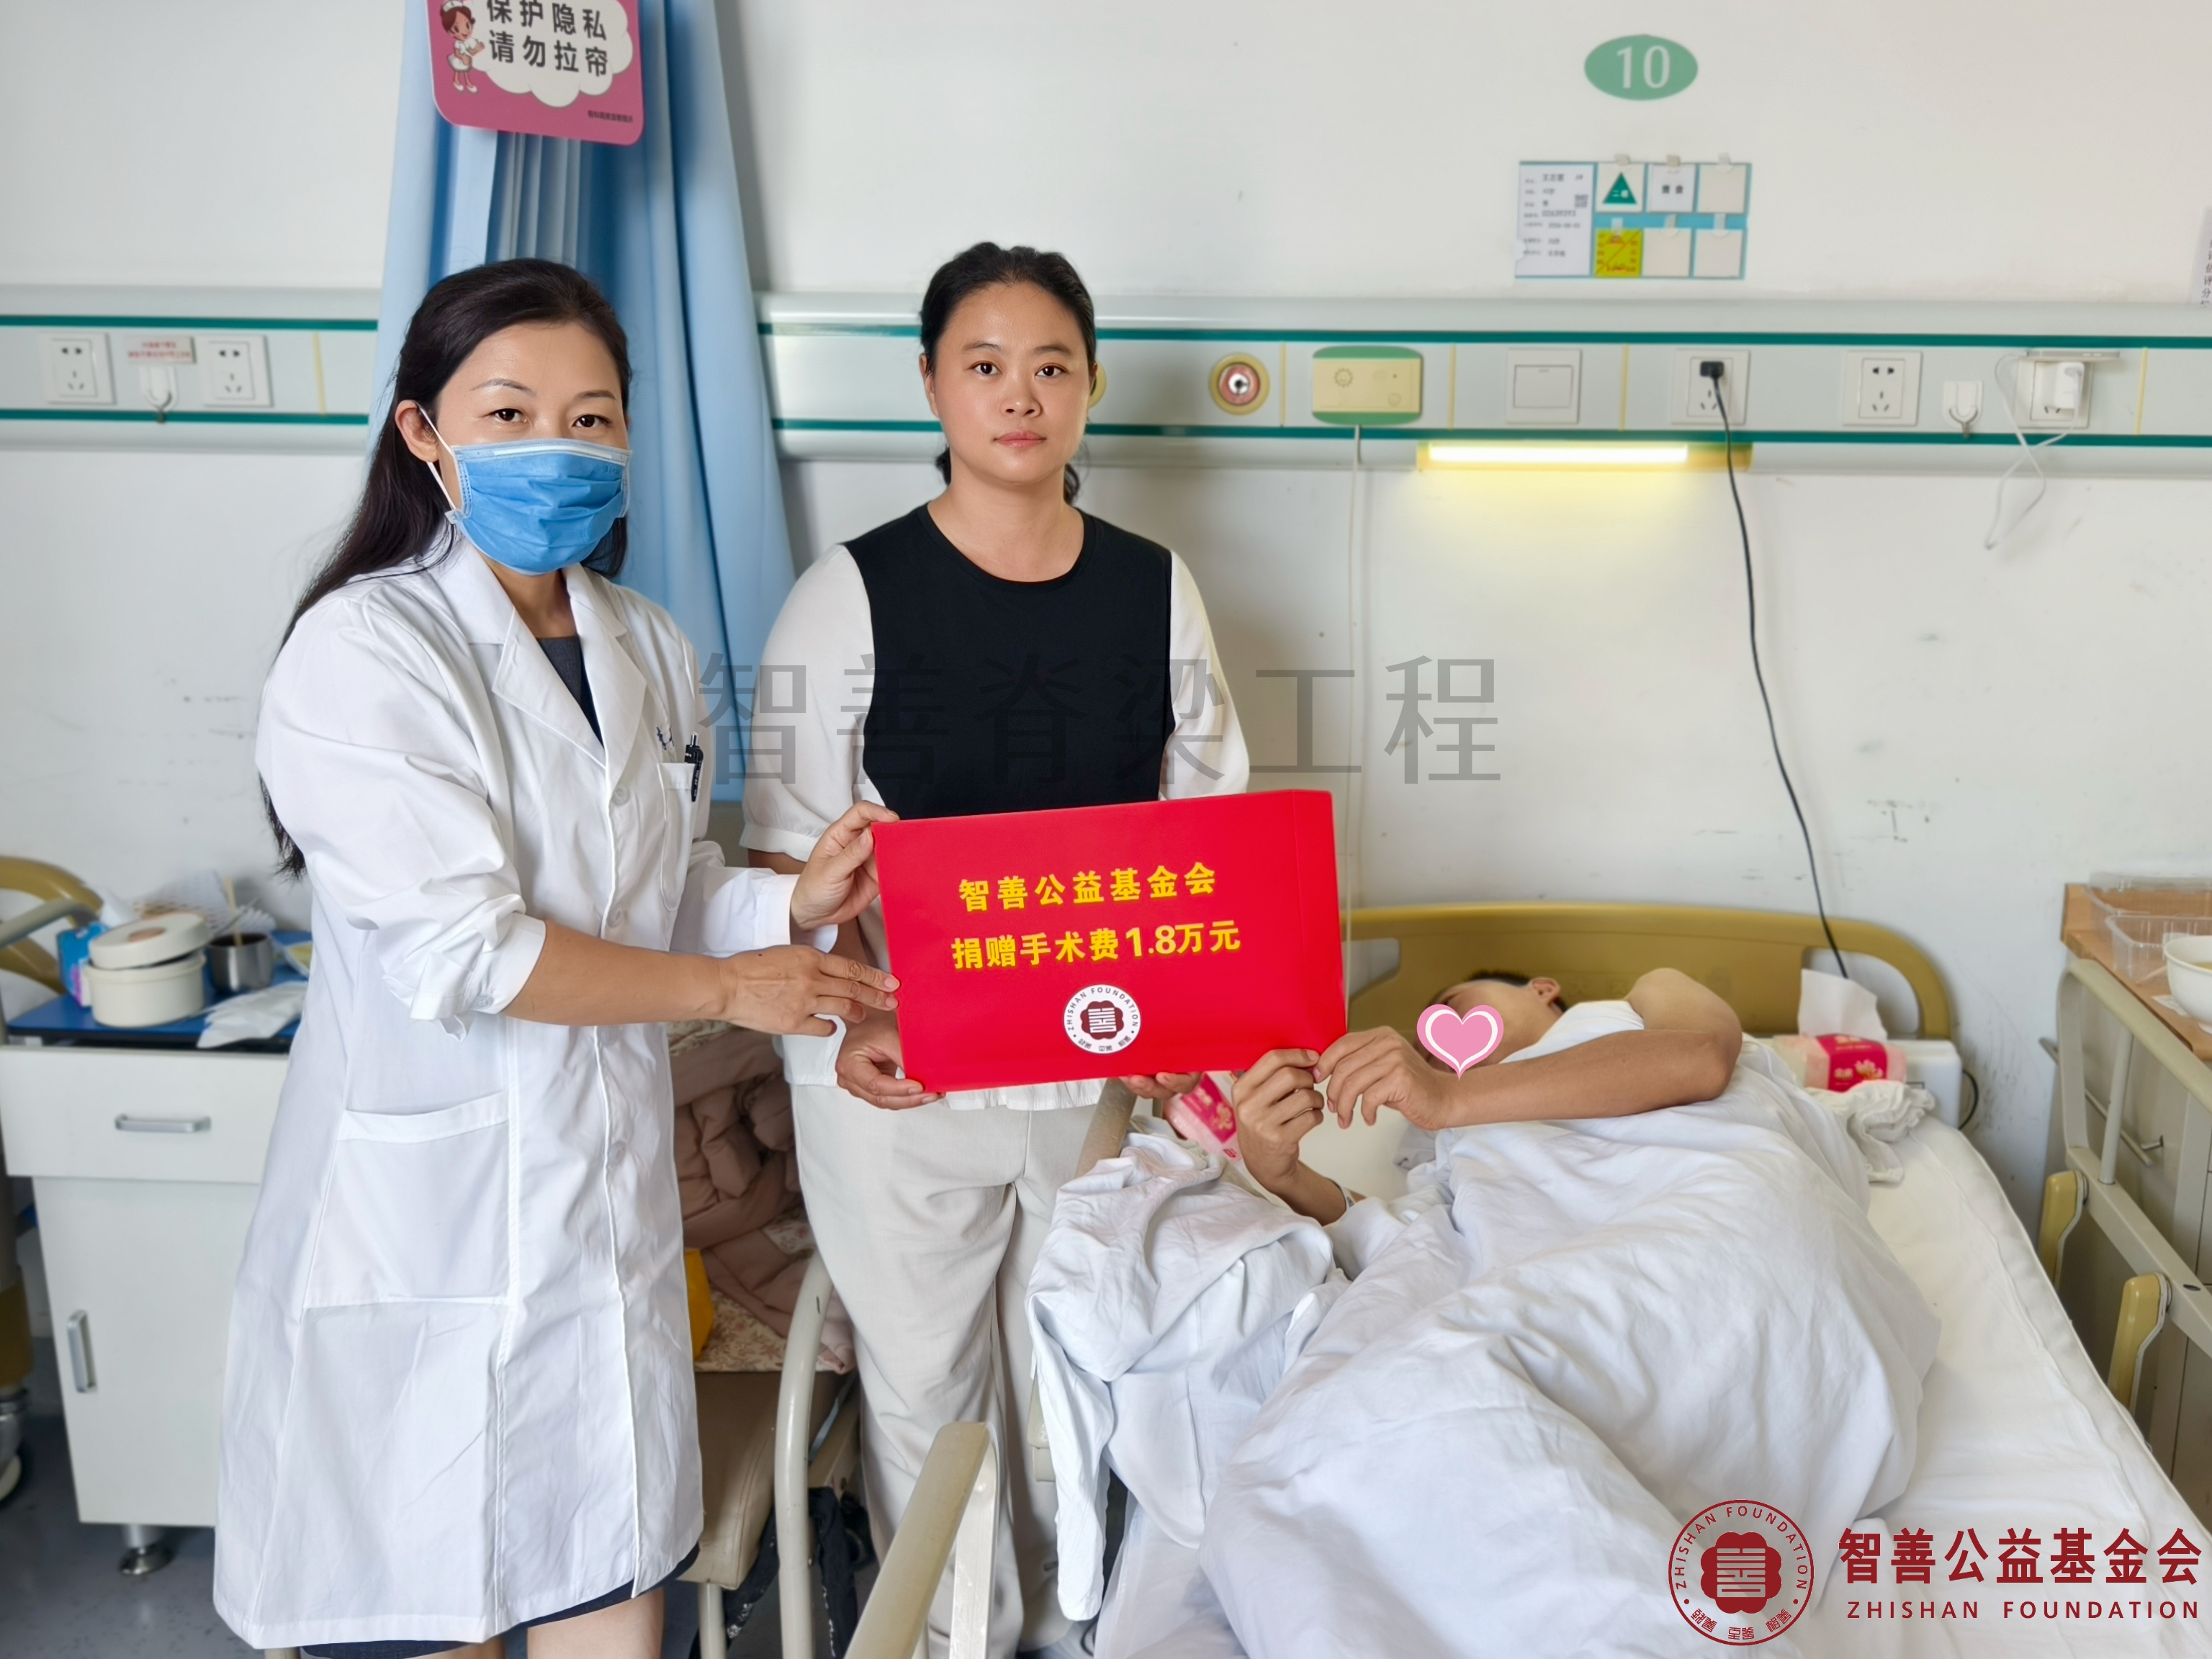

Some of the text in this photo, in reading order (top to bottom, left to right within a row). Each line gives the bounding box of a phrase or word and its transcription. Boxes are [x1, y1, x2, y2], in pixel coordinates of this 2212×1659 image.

[487, 0, 607, 41] 保护隐私
[489, 30, 608, 77] 请勿拉帘
[1617, 45, 1671, 89] 10
[958, 862, 1215, 912] 智善公益基金会
[951, 920, 1241, 969] 捐赠手术费1.8万元
[1066, 987, 1138, 1031] ZHISHAN FOUNDATION
